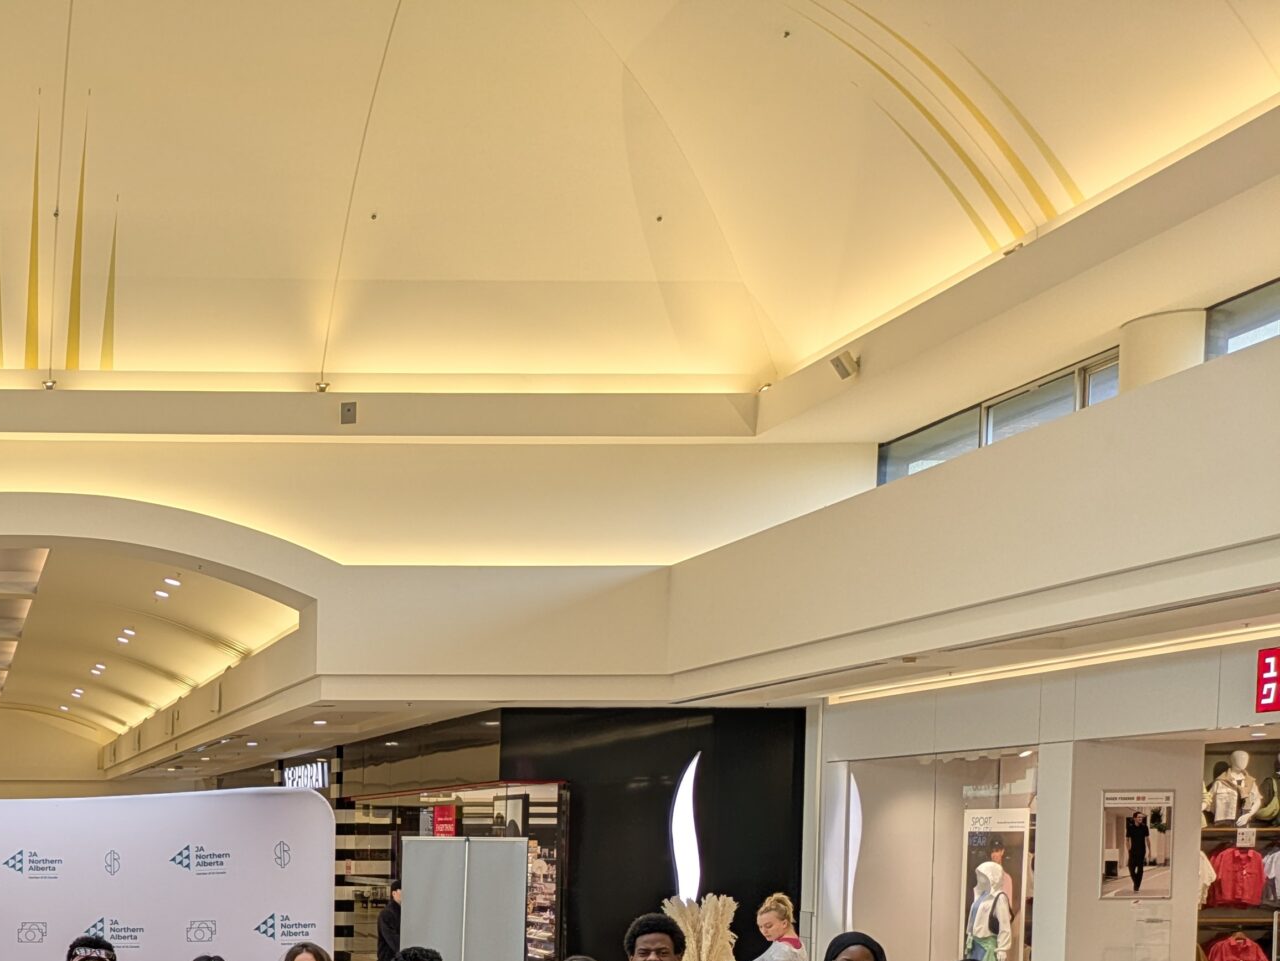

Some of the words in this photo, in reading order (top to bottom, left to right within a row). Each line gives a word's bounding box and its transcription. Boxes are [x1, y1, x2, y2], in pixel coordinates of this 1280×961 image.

[195, 852, 231, 860] Northern
[280, 914, 290, 922] JA
[109, 926, 144, 934] Northern
[280, 922, 316, 930] Northern
